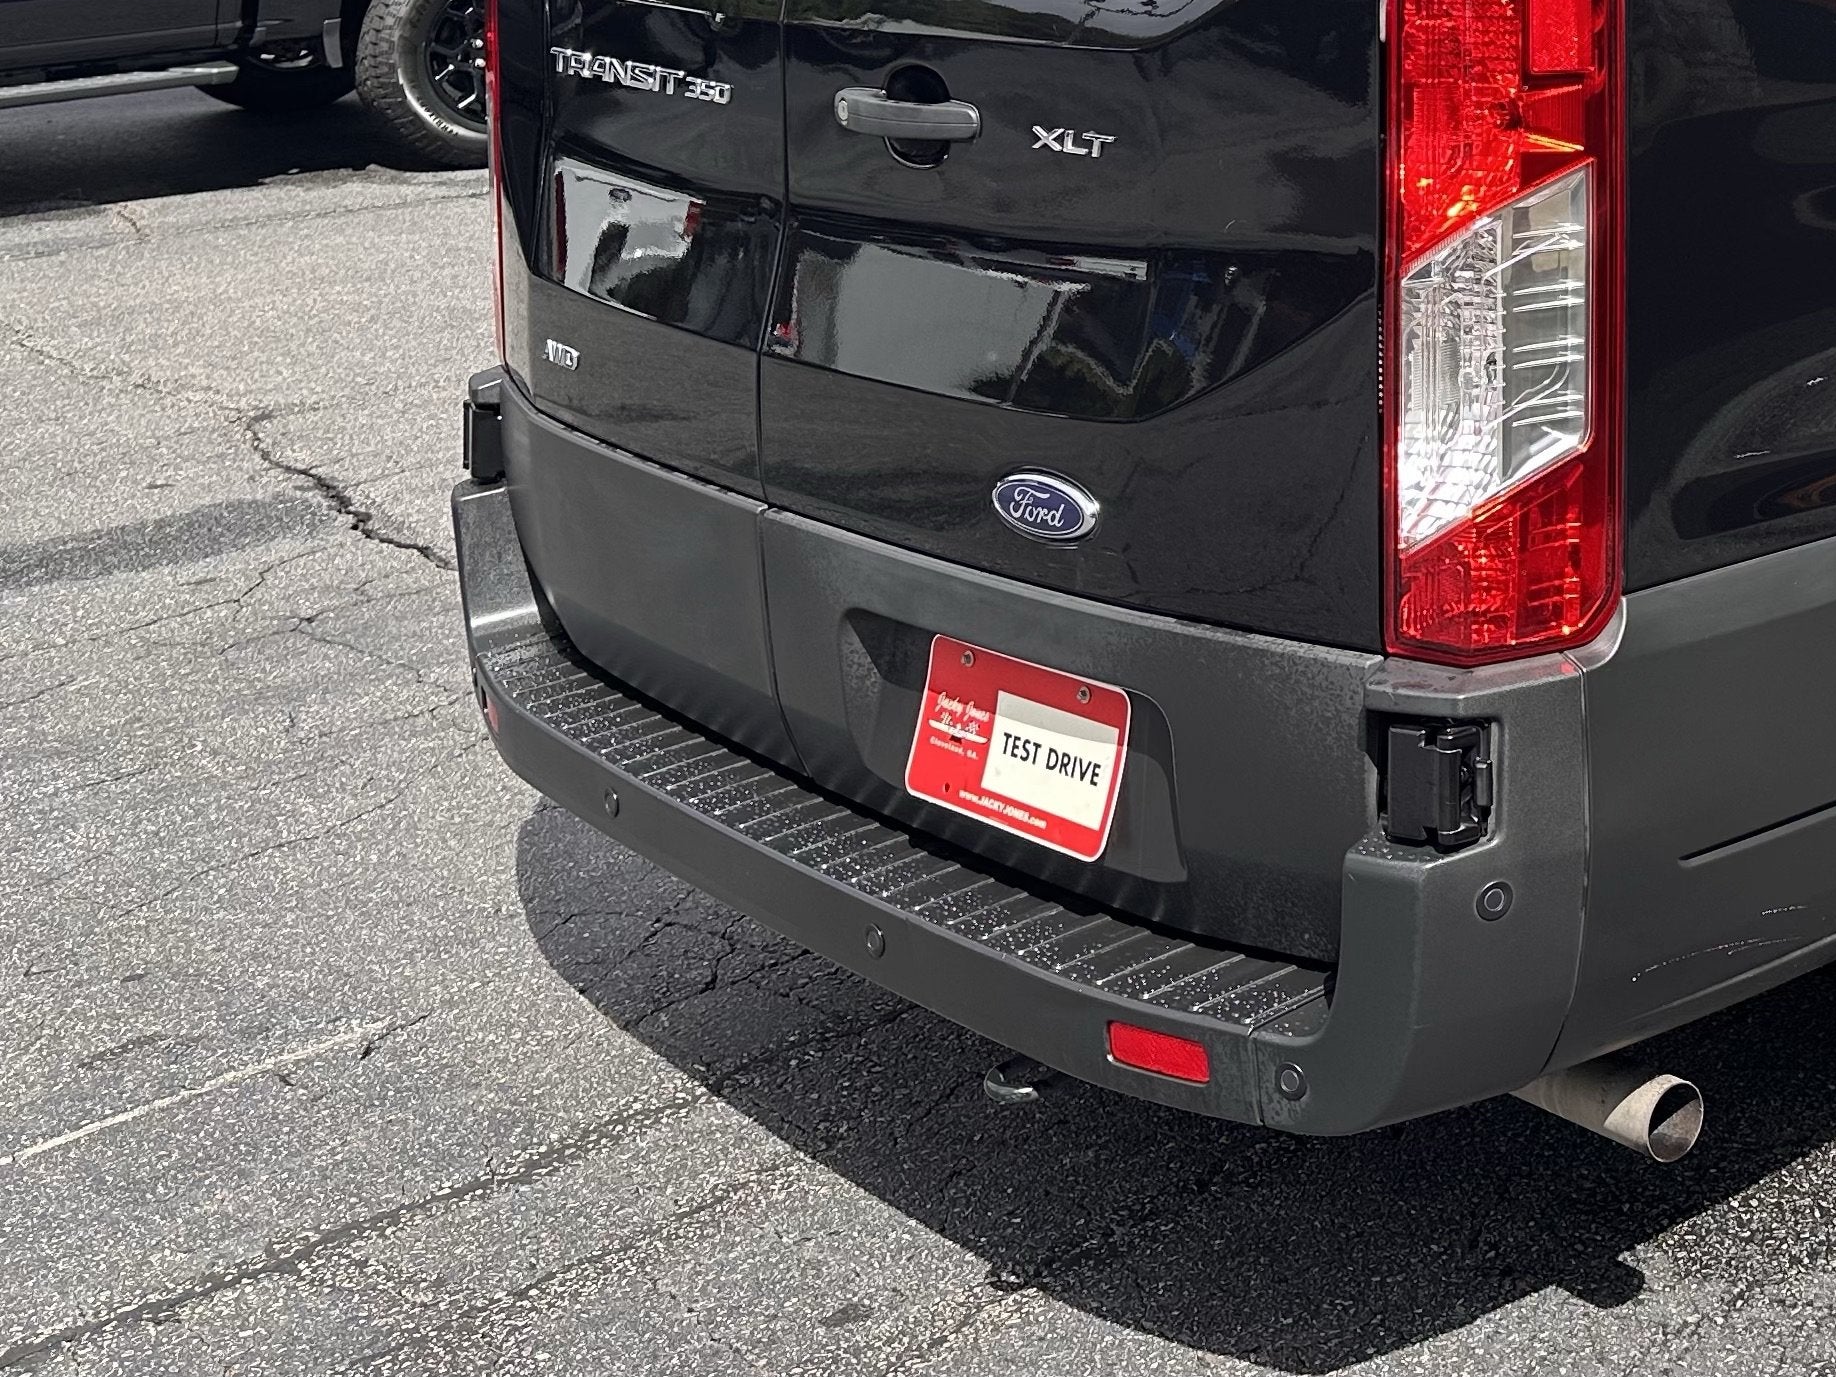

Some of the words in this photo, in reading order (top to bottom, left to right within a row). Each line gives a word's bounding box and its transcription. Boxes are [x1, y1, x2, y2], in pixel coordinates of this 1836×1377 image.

[550, 46, 686, 95] TRANSIT
[684, 76, 735, 105] 350
[1031, 125, 1118, 158] XLT
[542, 338, 580, 371] AWD
[1009, 486, 1065, 527] Ford
[935, 691, 963, 718] Jacky
[963, 701, 990, 722] Jones
[1002, 732, 1042, 766] TEST
[1045, 748, 1102, 787] DRIVE
[959, 789, 1047, 830] www.JACKYJONES.com
